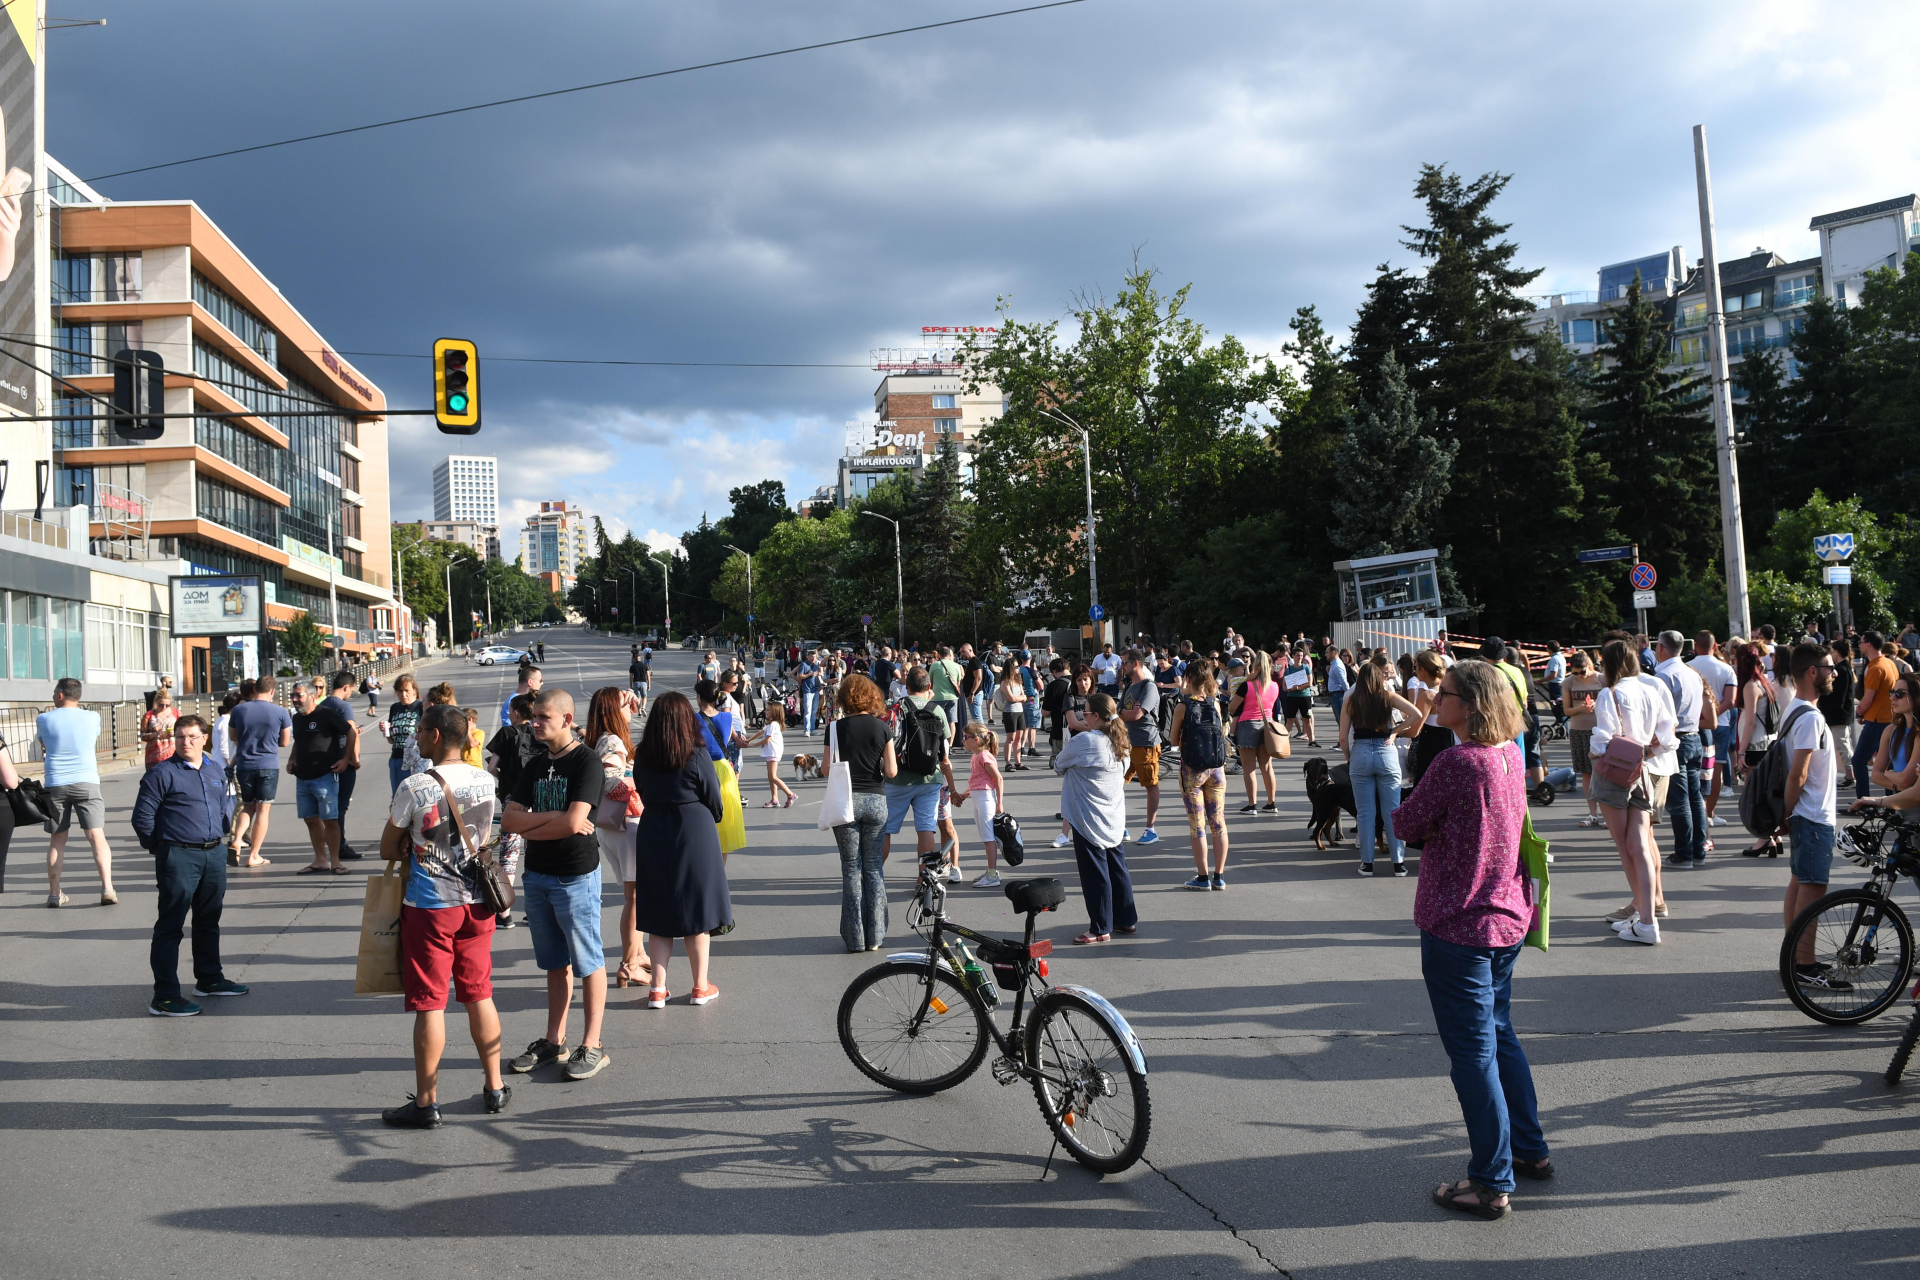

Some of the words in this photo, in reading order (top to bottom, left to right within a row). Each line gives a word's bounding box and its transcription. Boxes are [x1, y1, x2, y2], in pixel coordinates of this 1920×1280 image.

[877, 430, 926, 447] Dent
[853, 457, 917, 466] IMPLANTOLOGY
[183, 591, 209, 600] ДОМ
